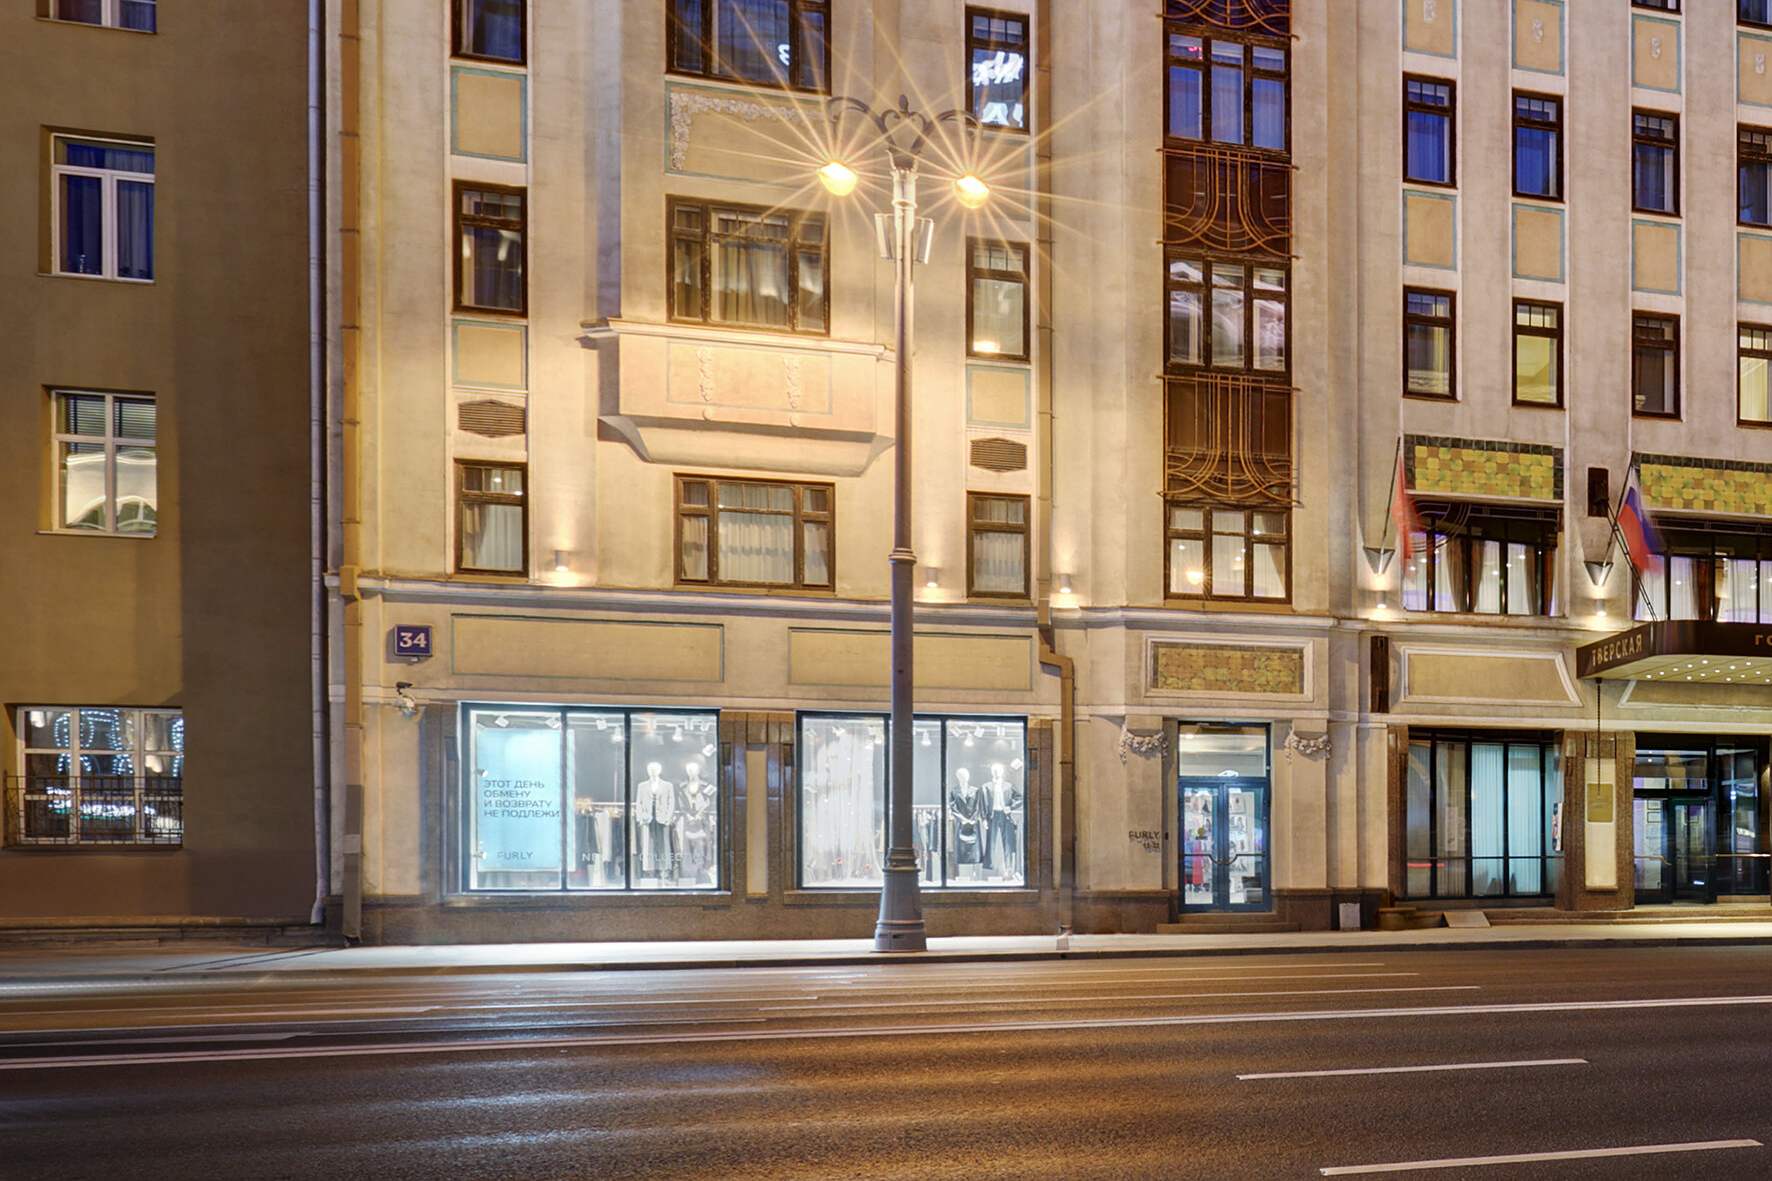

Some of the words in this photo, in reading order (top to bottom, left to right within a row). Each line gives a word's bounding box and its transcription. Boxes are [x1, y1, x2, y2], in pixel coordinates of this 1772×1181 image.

[400, 632, 427, 648] 34
[1591, 633, 1643, 667] ТВЕРСКАЯ
[483, 780, 511, 788] ЭТОТ
[514, 780, 545, 789] ДЕНЬ
[483, 790, 531, 798] ОБМЕНУ
[484, 800, 492, 808] И
[495, 799, 552, 808] ВОЗВРАТУ
[484, 809, 499, 818] НЕ
[502, 809, 560, 819] ПОДЛЕЖИ
[1129, 831, 1160, 839] FURLY
[497, 851, 533, 860] FURLY
